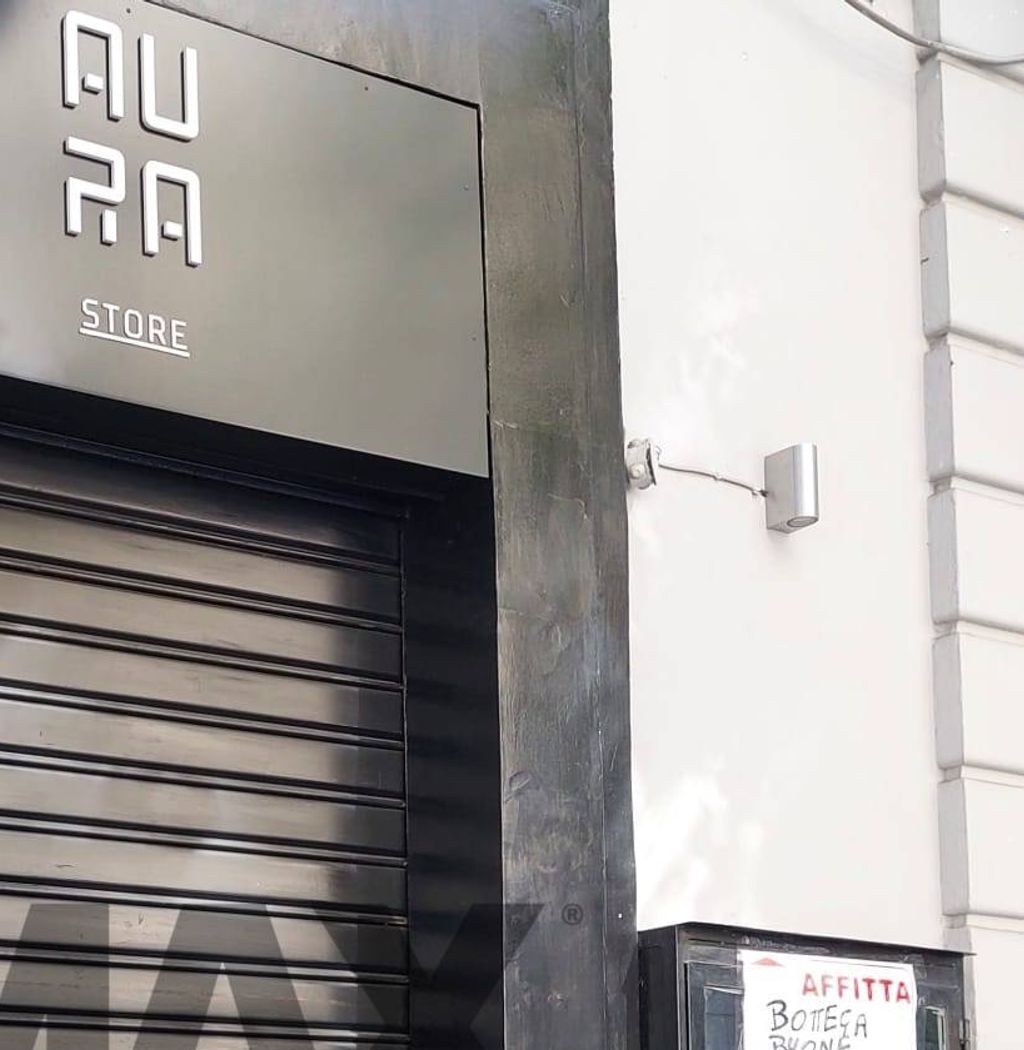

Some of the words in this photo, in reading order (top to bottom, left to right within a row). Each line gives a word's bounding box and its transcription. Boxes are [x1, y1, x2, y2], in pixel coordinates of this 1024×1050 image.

[61, 10, 199, 142] AU
[63, 136, 202, 267] RA
[81, 298, 189, 352] STORE
[802, 973, 911, 1003] AFFITTA
[767, 1000, 868, 1038] BOTTEGA
